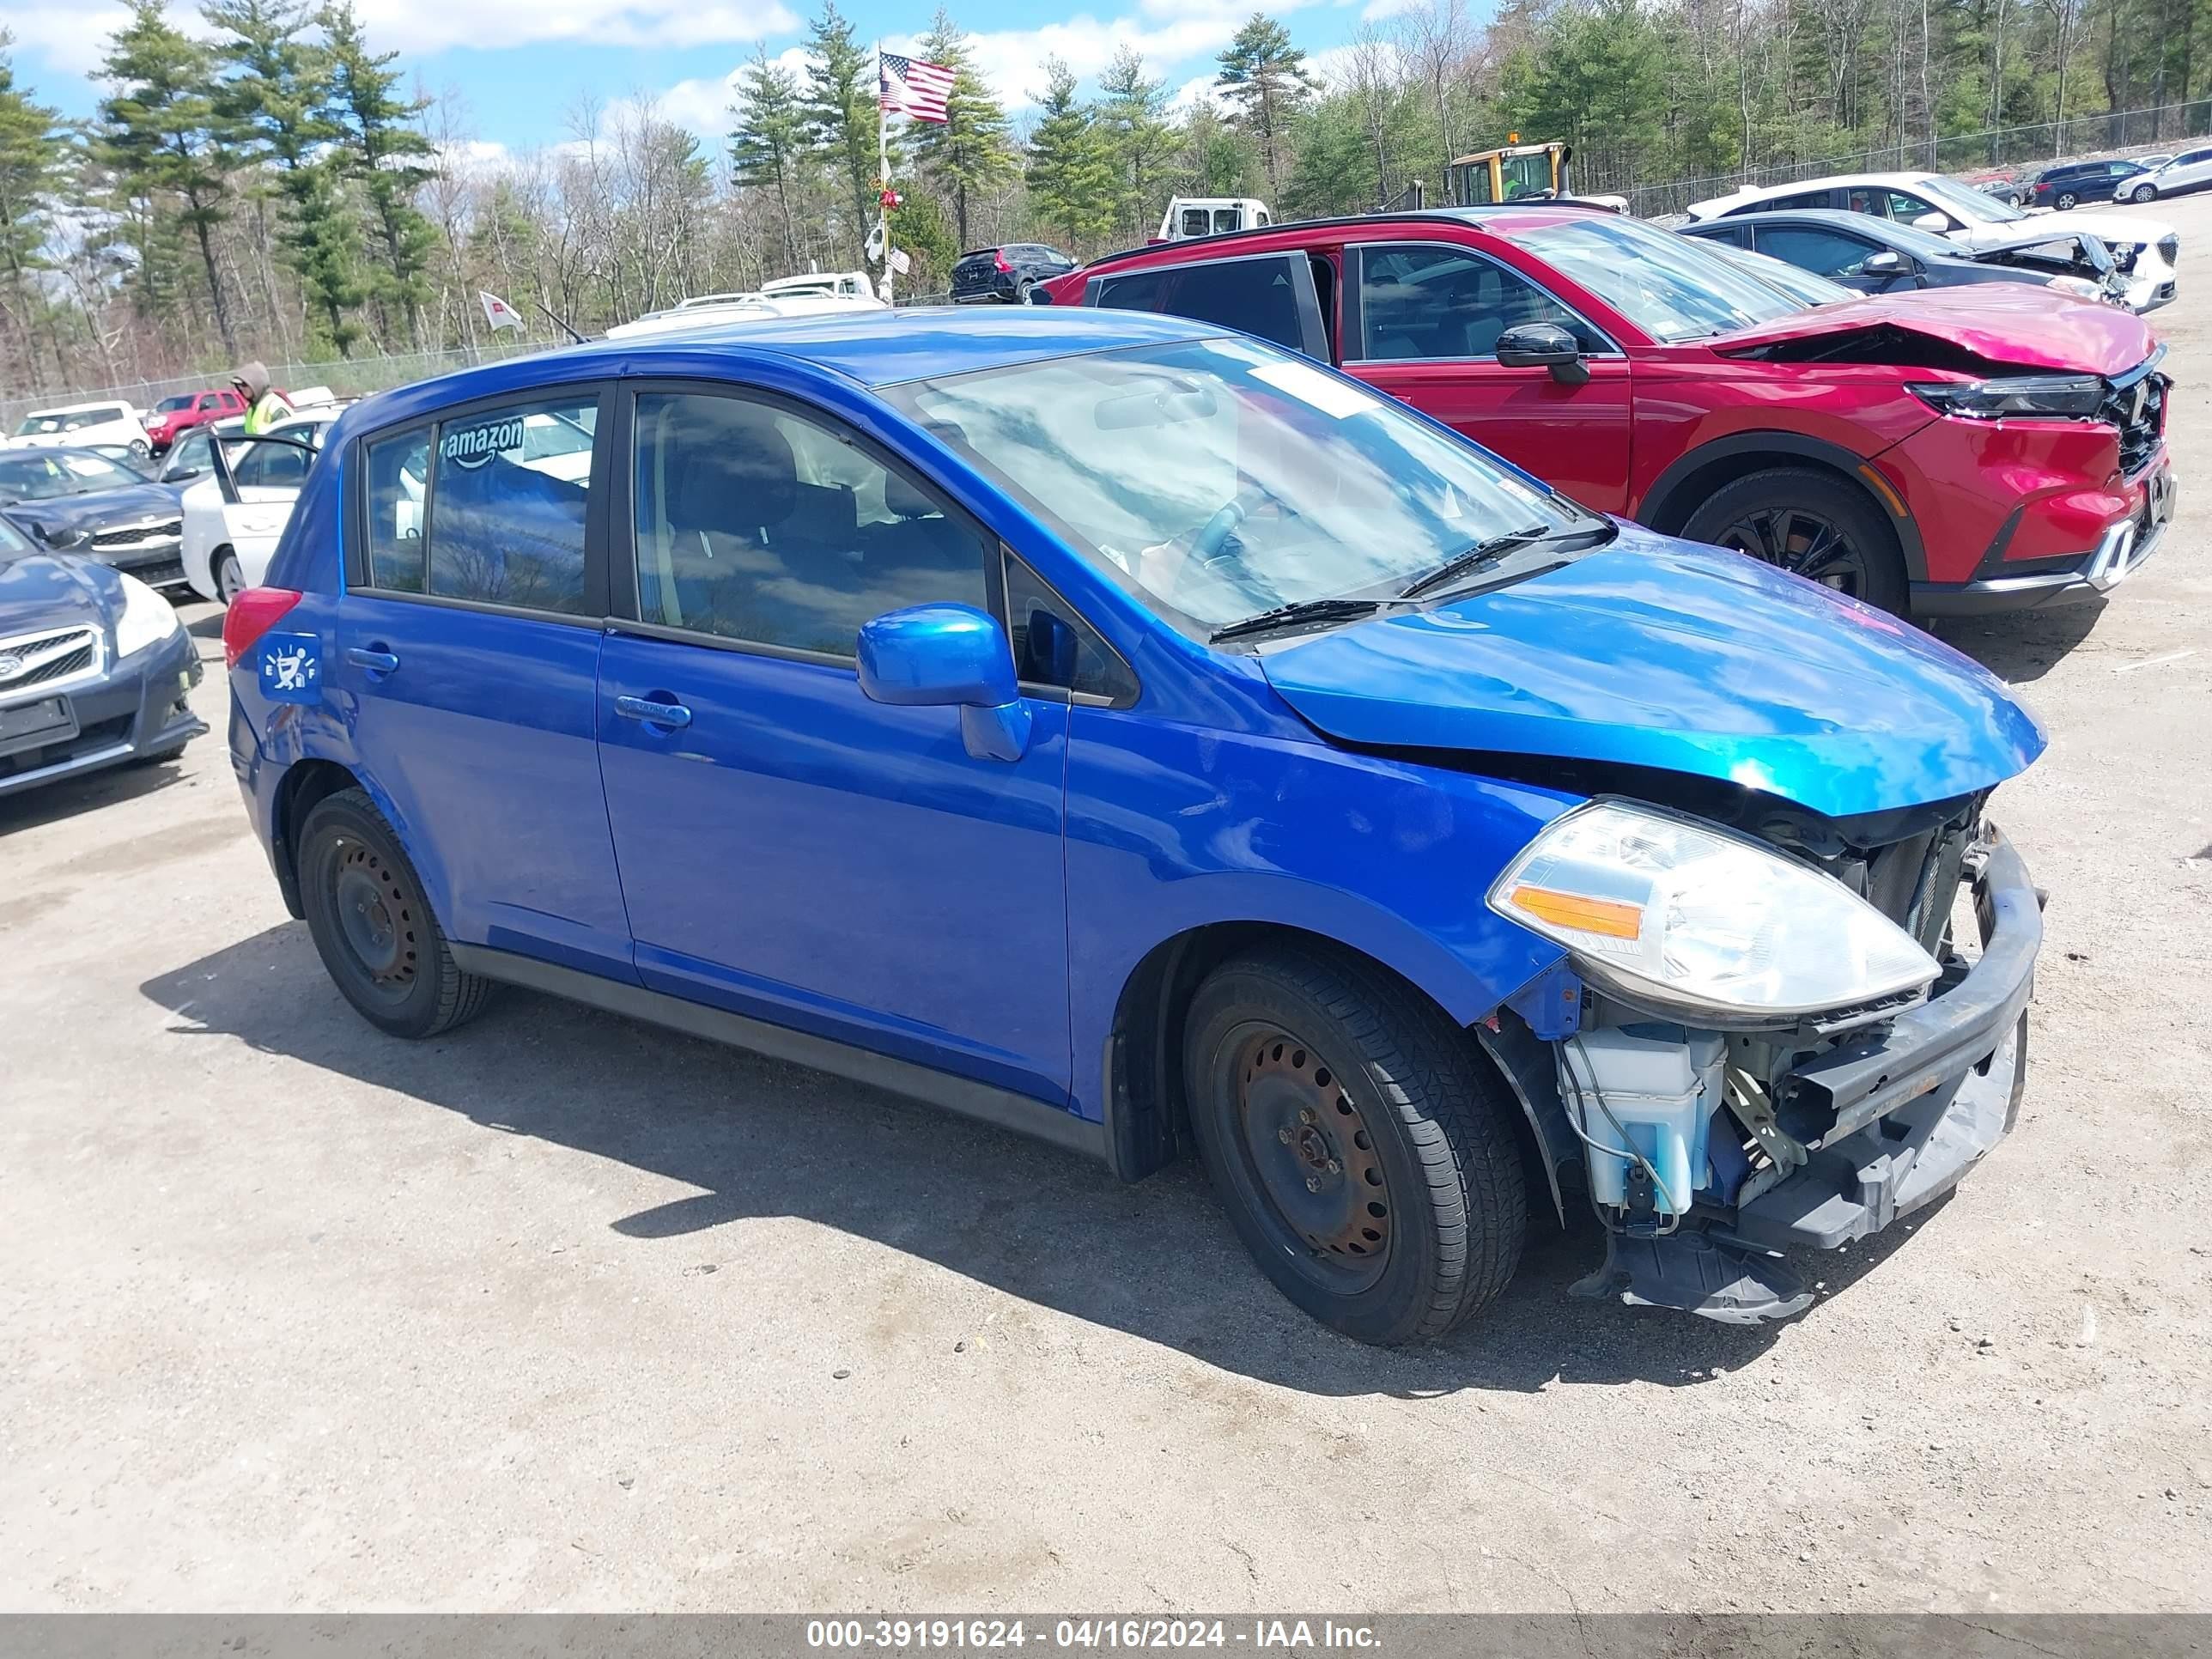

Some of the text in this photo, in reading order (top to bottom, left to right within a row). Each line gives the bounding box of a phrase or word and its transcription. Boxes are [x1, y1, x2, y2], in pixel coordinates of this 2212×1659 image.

[446, 422, 523, 459] amazon
[265, 665, 273, 676] E
[308, 668, 315, 679] F
